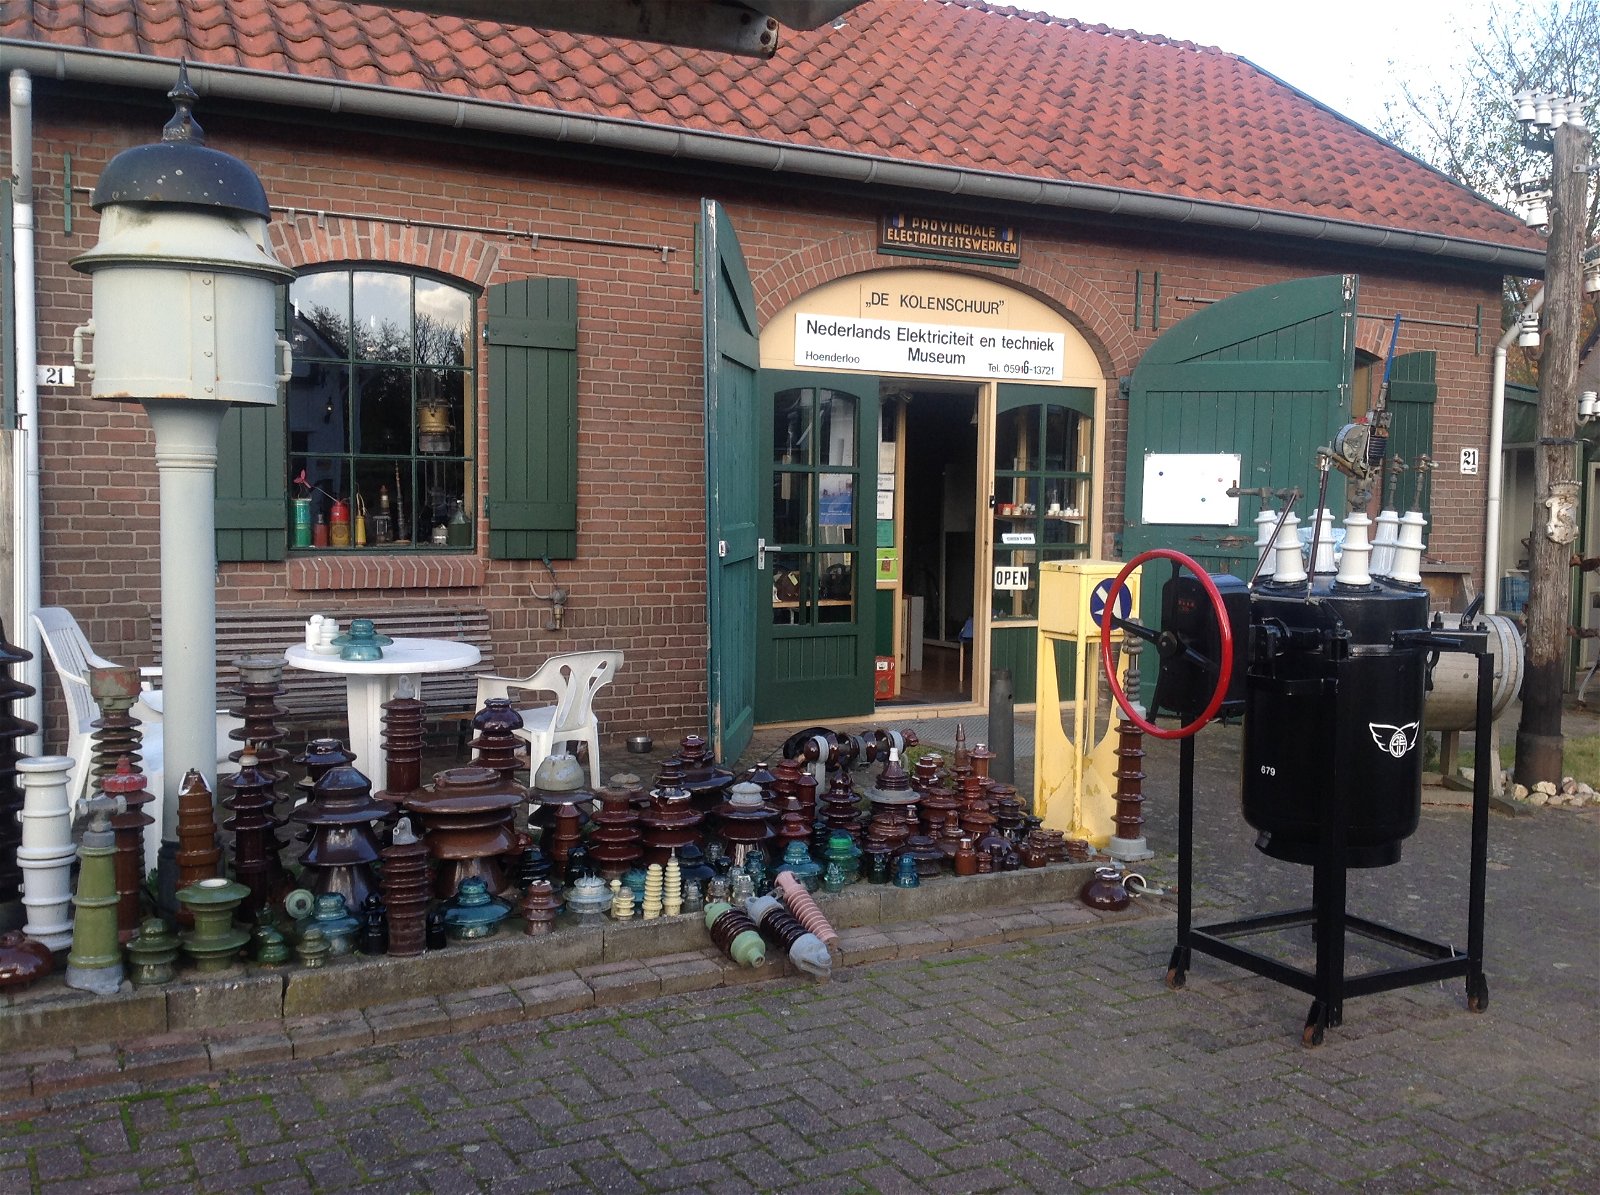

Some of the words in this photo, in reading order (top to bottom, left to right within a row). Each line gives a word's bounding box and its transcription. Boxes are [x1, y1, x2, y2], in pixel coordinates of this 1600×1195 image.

[912, 217, 996, 238] PROVINCIALE
[887, 228, 1017, 254] ELECTRICITEITSWERKEN
[806, 320, 891, 341] Nederlands
[897, 327, 974, 347] Elektriciteit
[980, 336, 996, 348] en
[1002, 335, 1055, 352] techniek
[805, 351, 860, 364] Hoenderloo
[908, 348, 966, 365] Museum
[46, 367, 64, 385] 21
[988, 363, 1001, 373] Tel.
[1463, 451, 1476, 466] 21
[996, 570, 1027, 586] OPEN
[1260, 765, 1276, 777] 679
